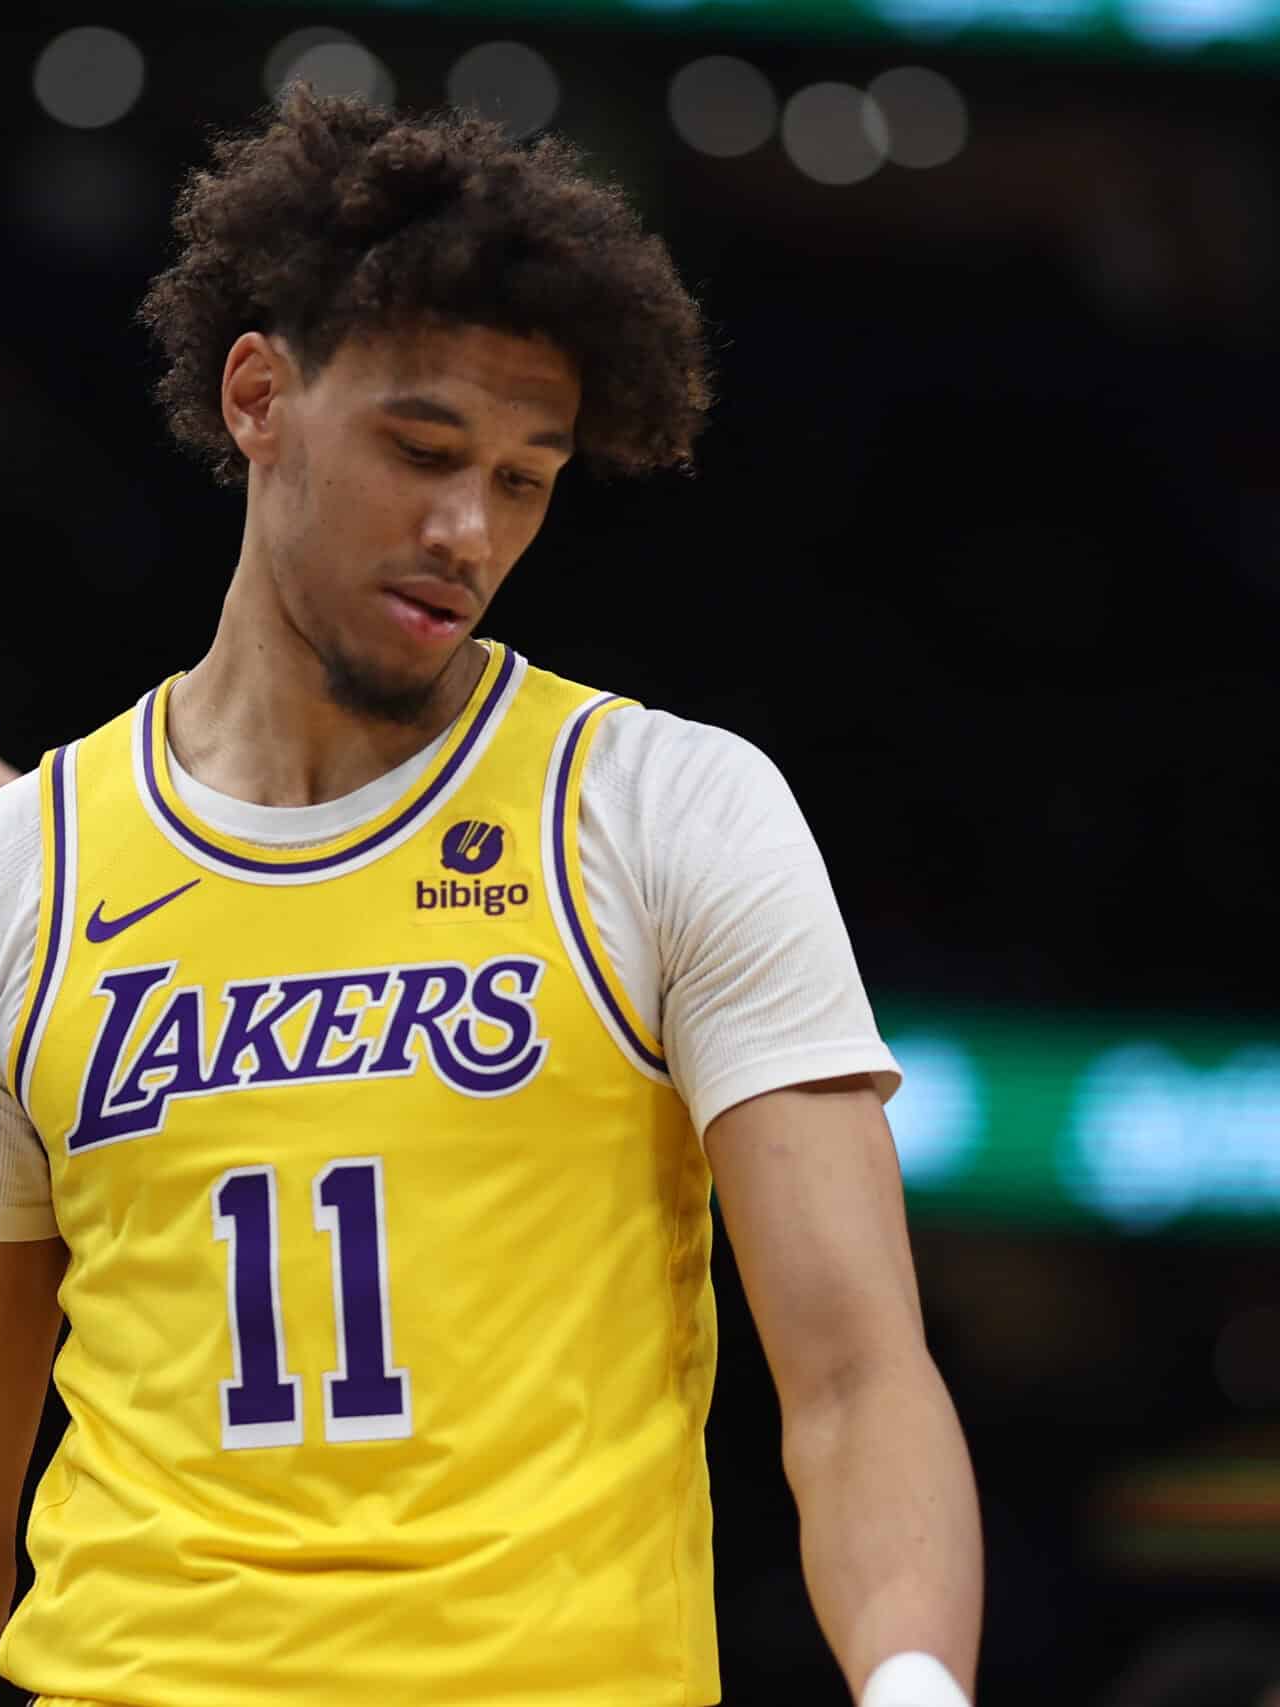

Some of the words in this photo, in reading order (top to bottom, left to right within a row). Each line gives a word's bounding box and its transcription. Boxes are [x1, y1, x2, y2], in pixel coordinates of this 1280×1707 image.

[416, 880, 529, 916] bibigo
[65, 954, 551, 1156] LAKERS
[211, 1155, 413, 1450] 11
